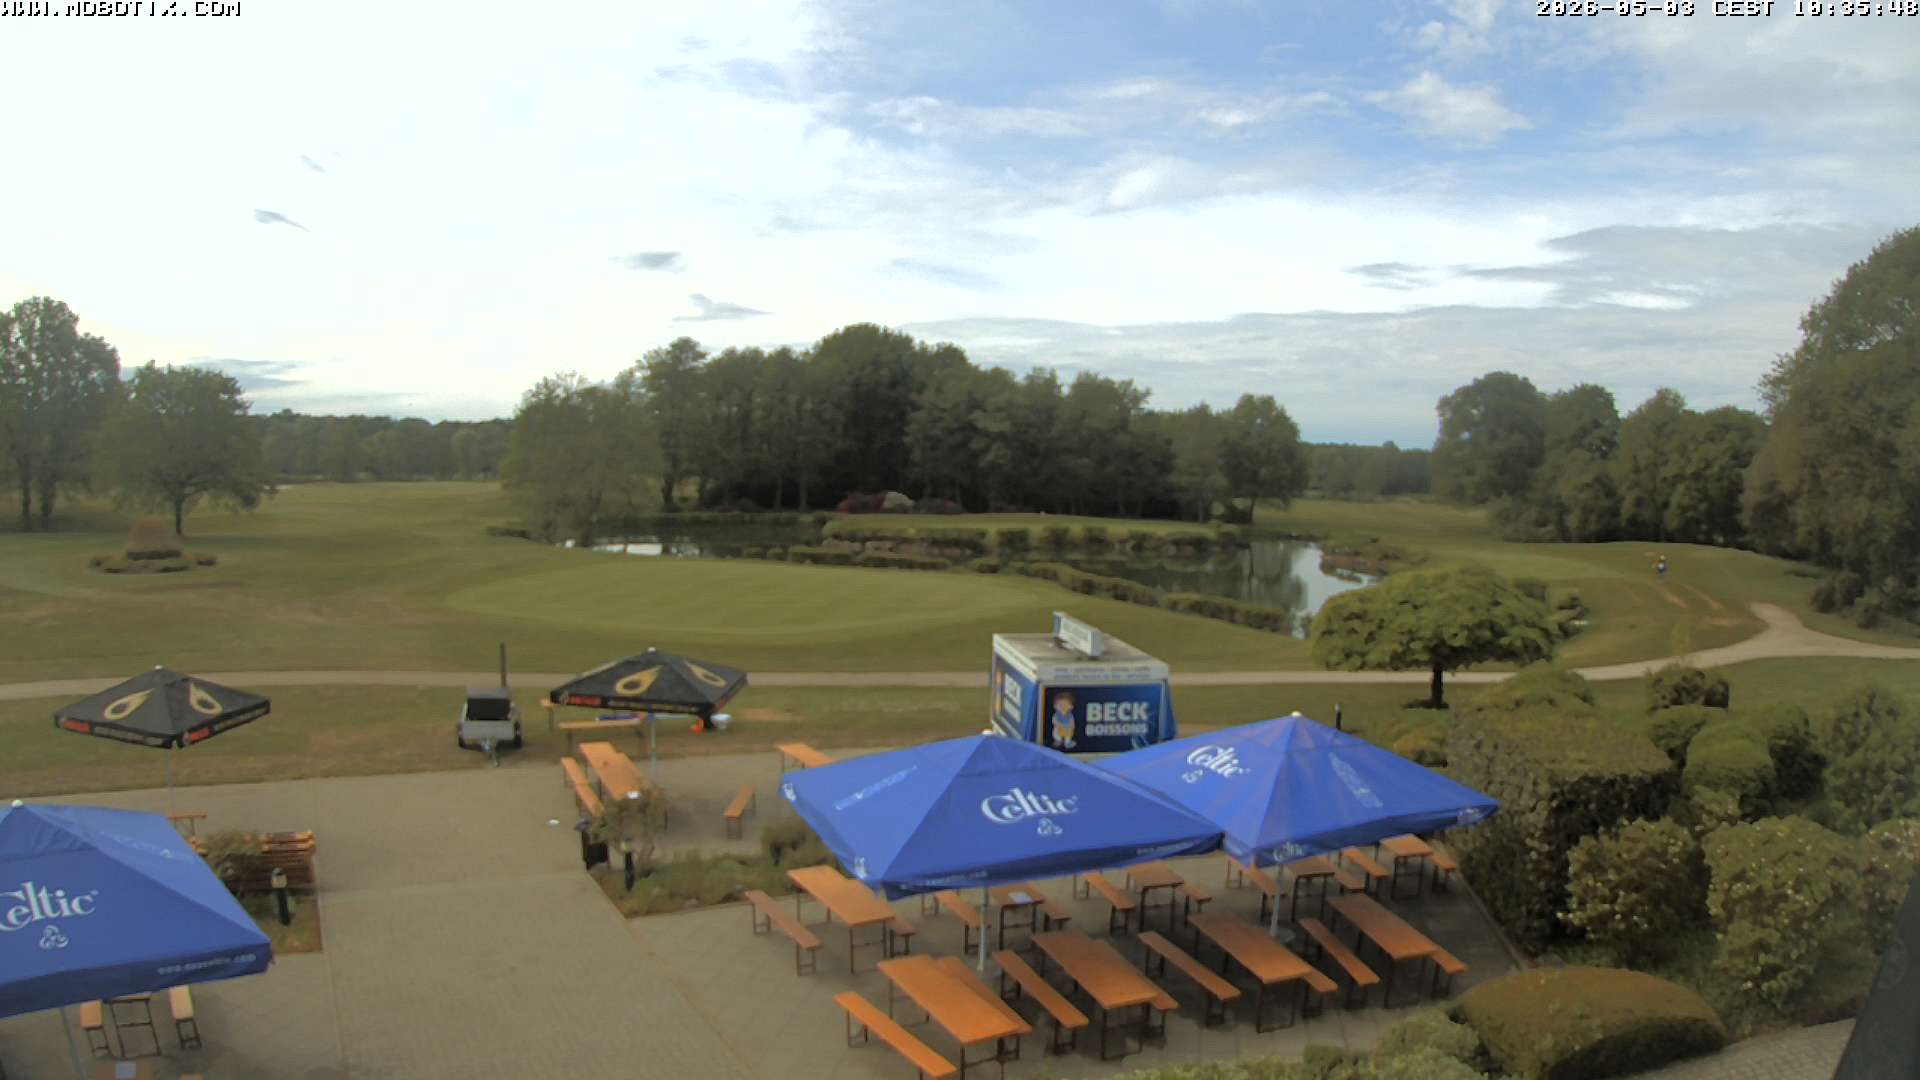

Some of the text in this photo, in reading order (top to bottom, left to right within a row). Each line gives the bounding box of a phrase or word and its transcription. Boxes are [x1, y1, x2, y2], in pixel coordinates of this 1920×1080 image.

[1086, 702, 1149, 721] BECK
[1085, 723, 1149, 737] BOISSONS
[1187, 745, 1244, 778] Celtic
[982, 787, 1078, 824] Celtic
